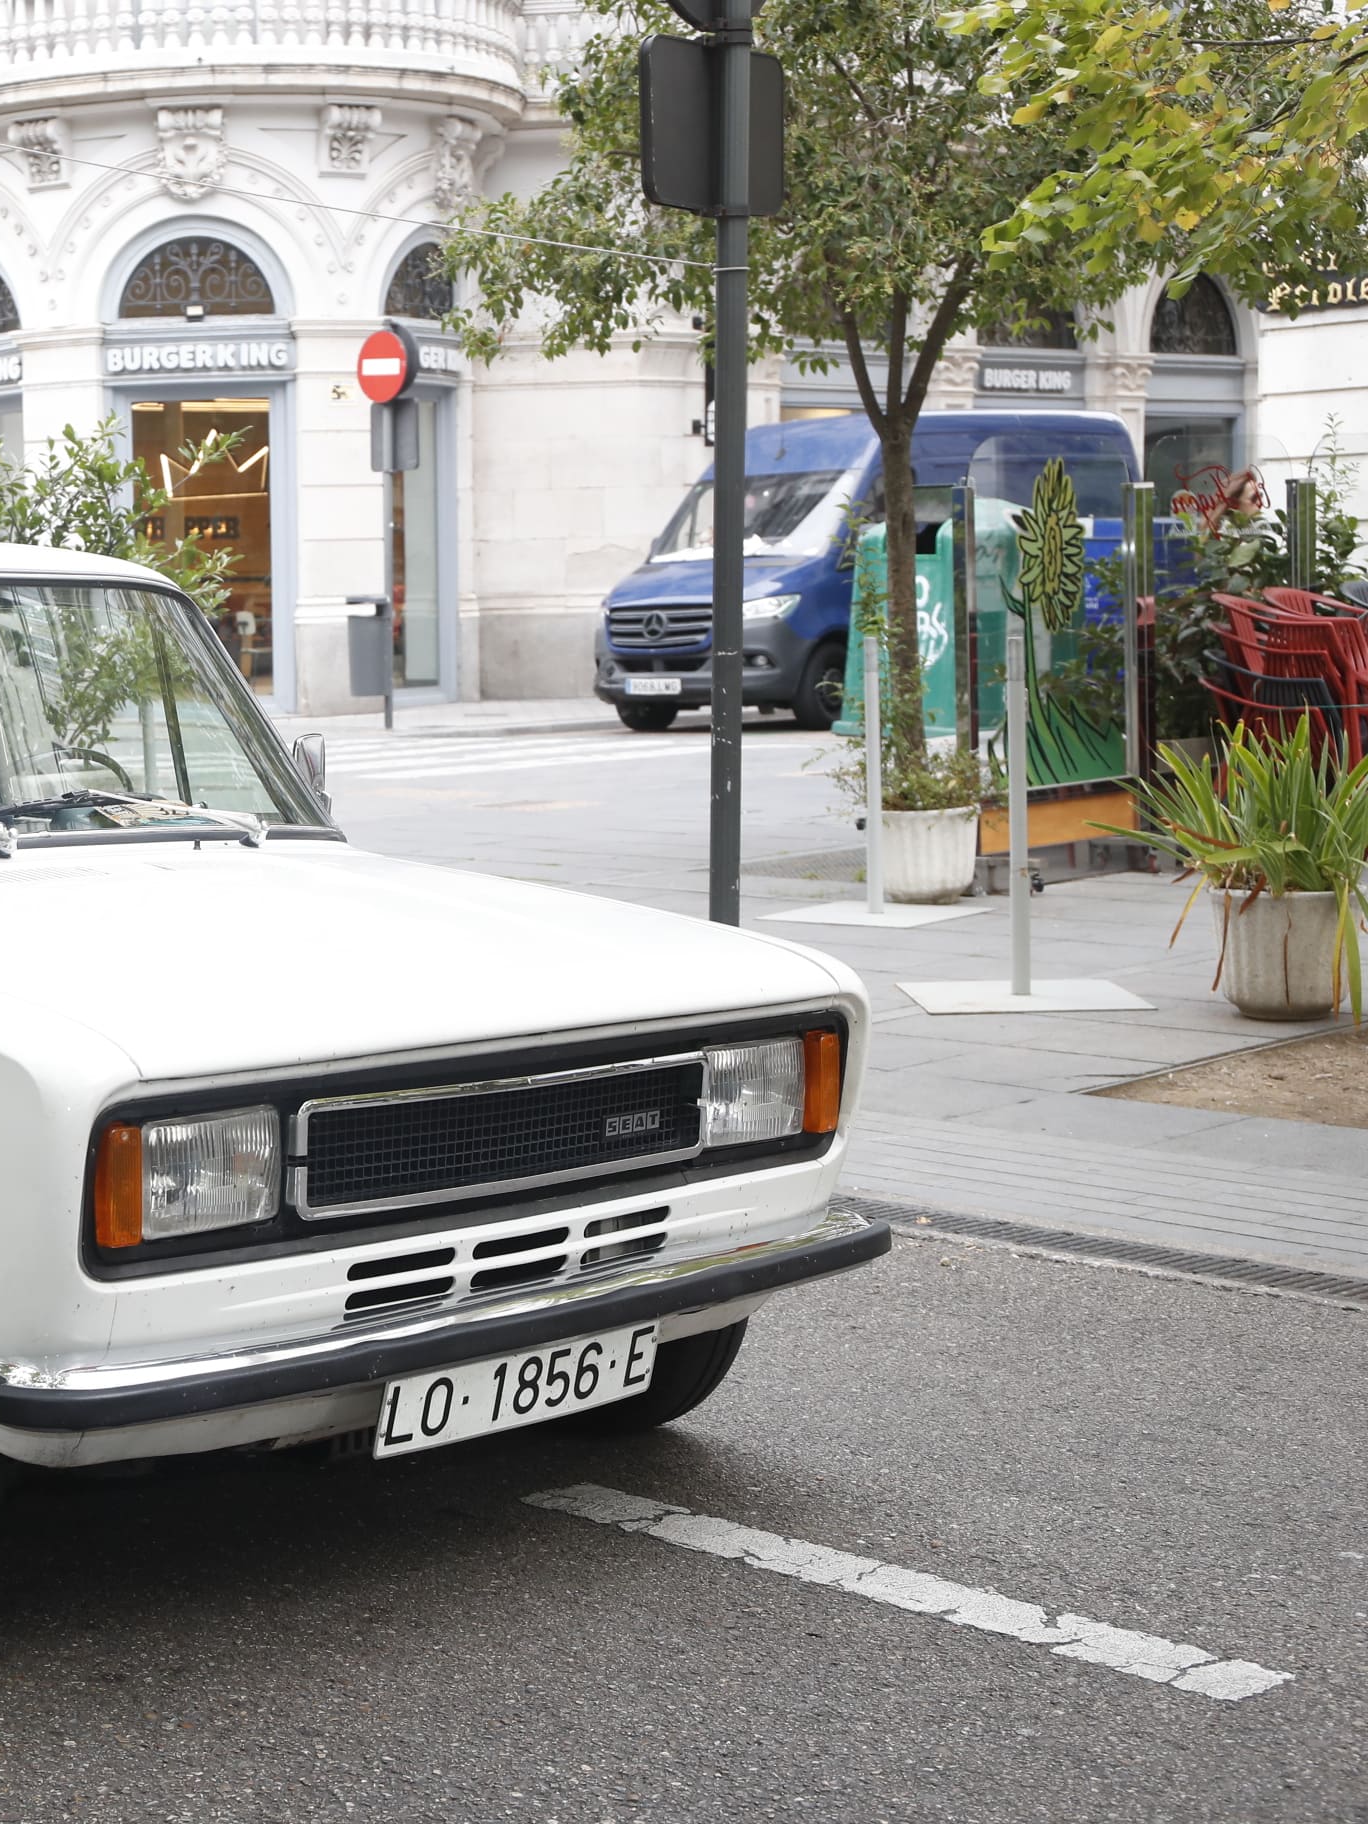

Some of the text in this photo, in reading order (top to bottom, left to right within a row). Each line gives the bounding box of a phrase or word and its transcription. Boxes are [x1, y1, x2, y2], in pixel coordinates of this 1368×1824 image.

[107, 342, 288, 372] BURGER KING
[984, 368, 1072, 390] BURGER KING
[606, 1110, 660, 1137] SEAT
